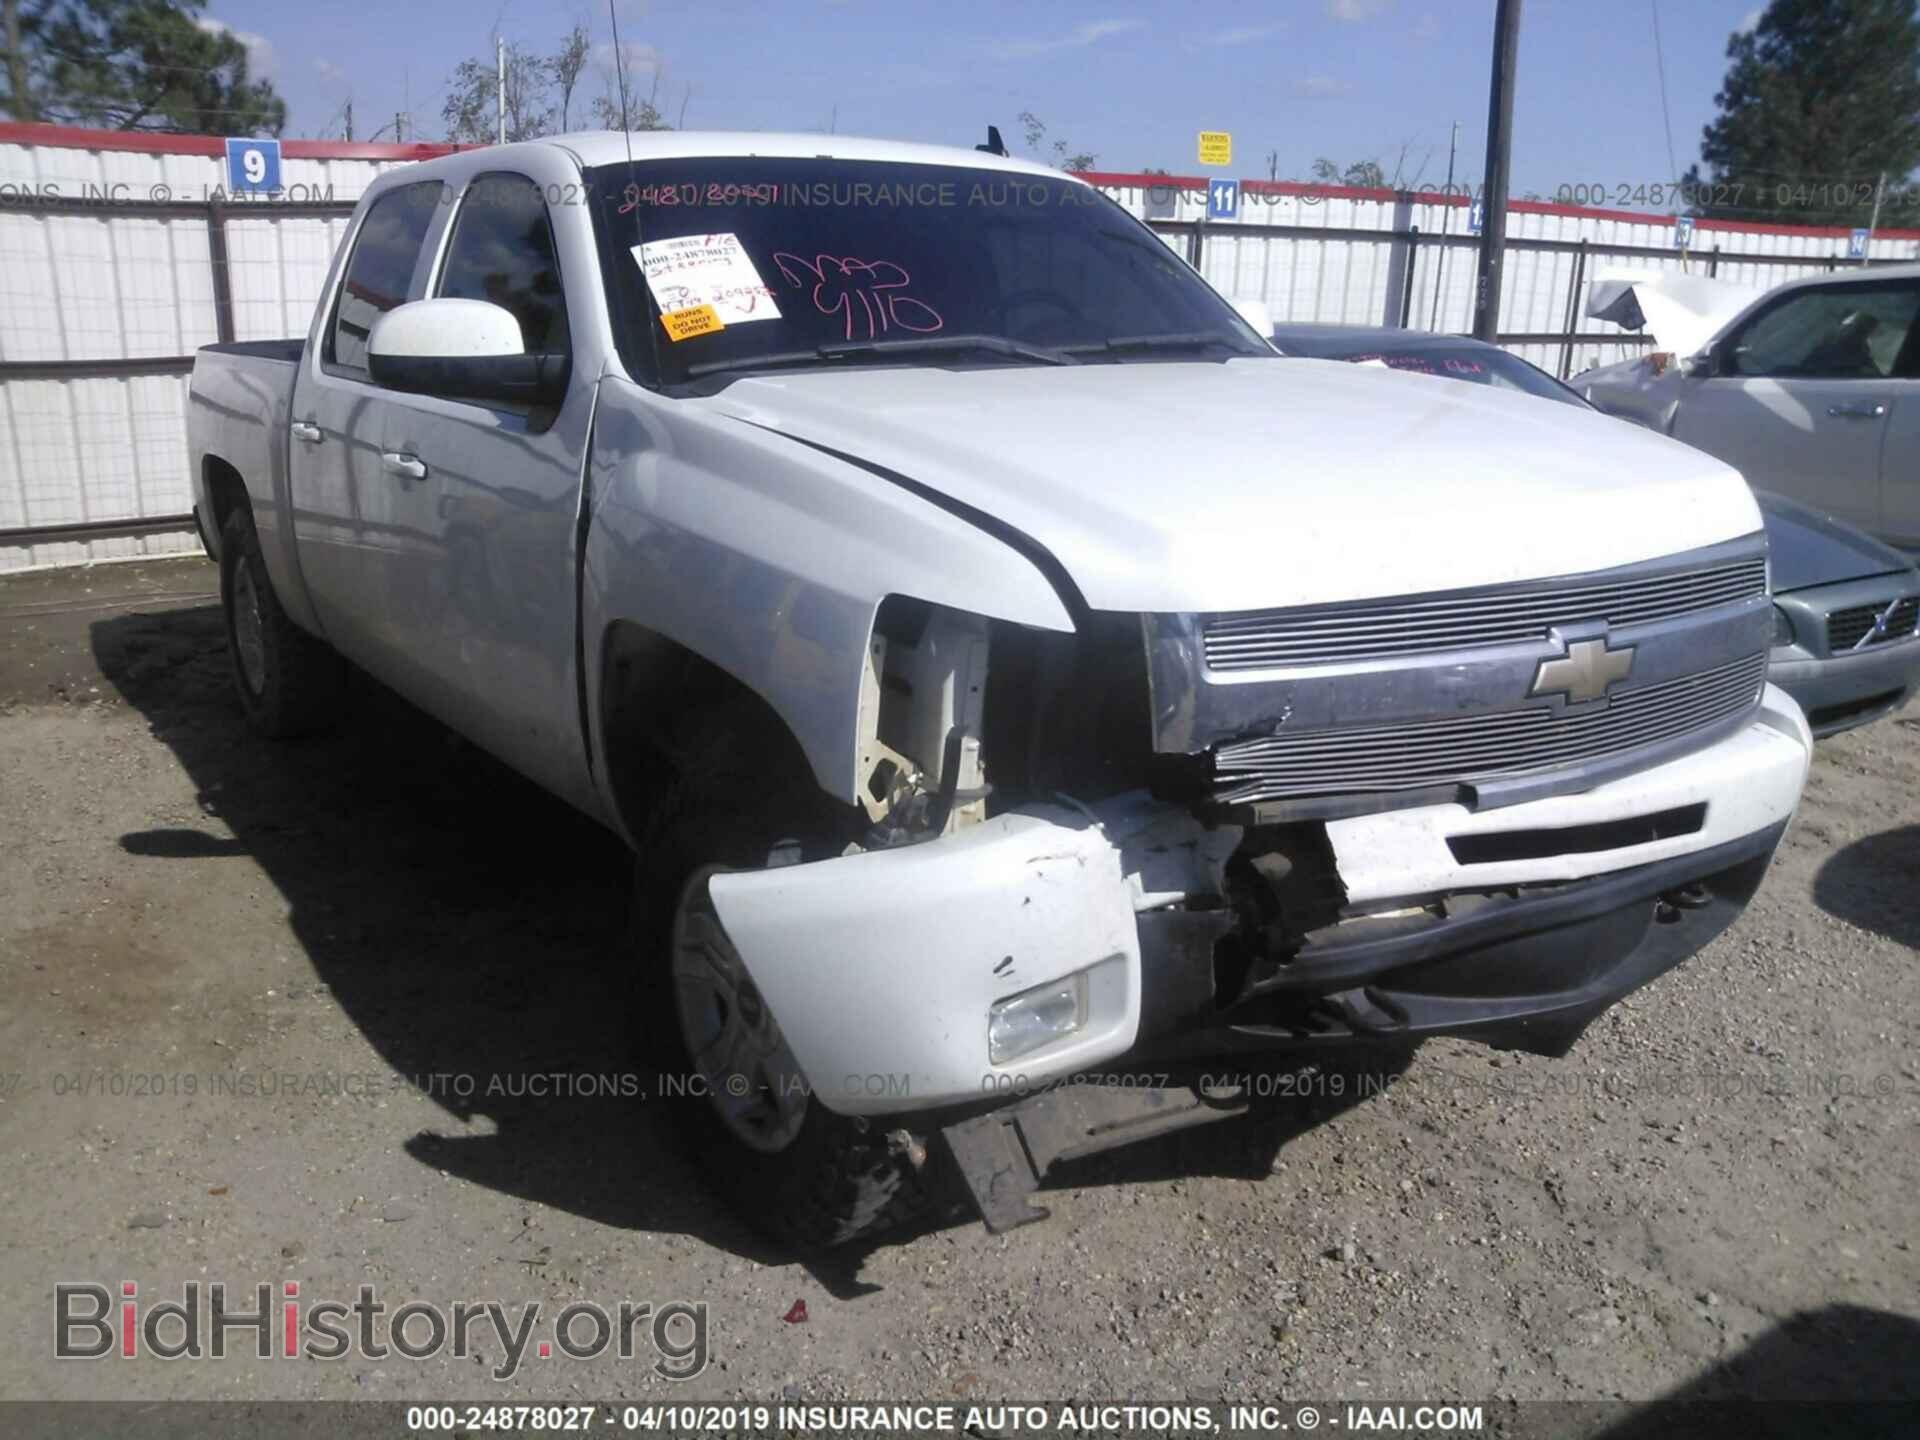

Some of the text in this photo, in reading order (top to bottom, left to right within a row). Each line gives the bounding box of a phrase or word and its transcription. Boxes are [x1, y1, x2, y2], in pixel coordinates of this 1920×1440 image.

[243, 149, 267, 183] 9
[1214, 186, 1234, 211] 11
[1473, 204, 1483, 225] 1
[672, 315, 711, 330] DO NOT
[674, 308, 703, 321] RUNS
[679, 322, 712, 335] DRIVE
